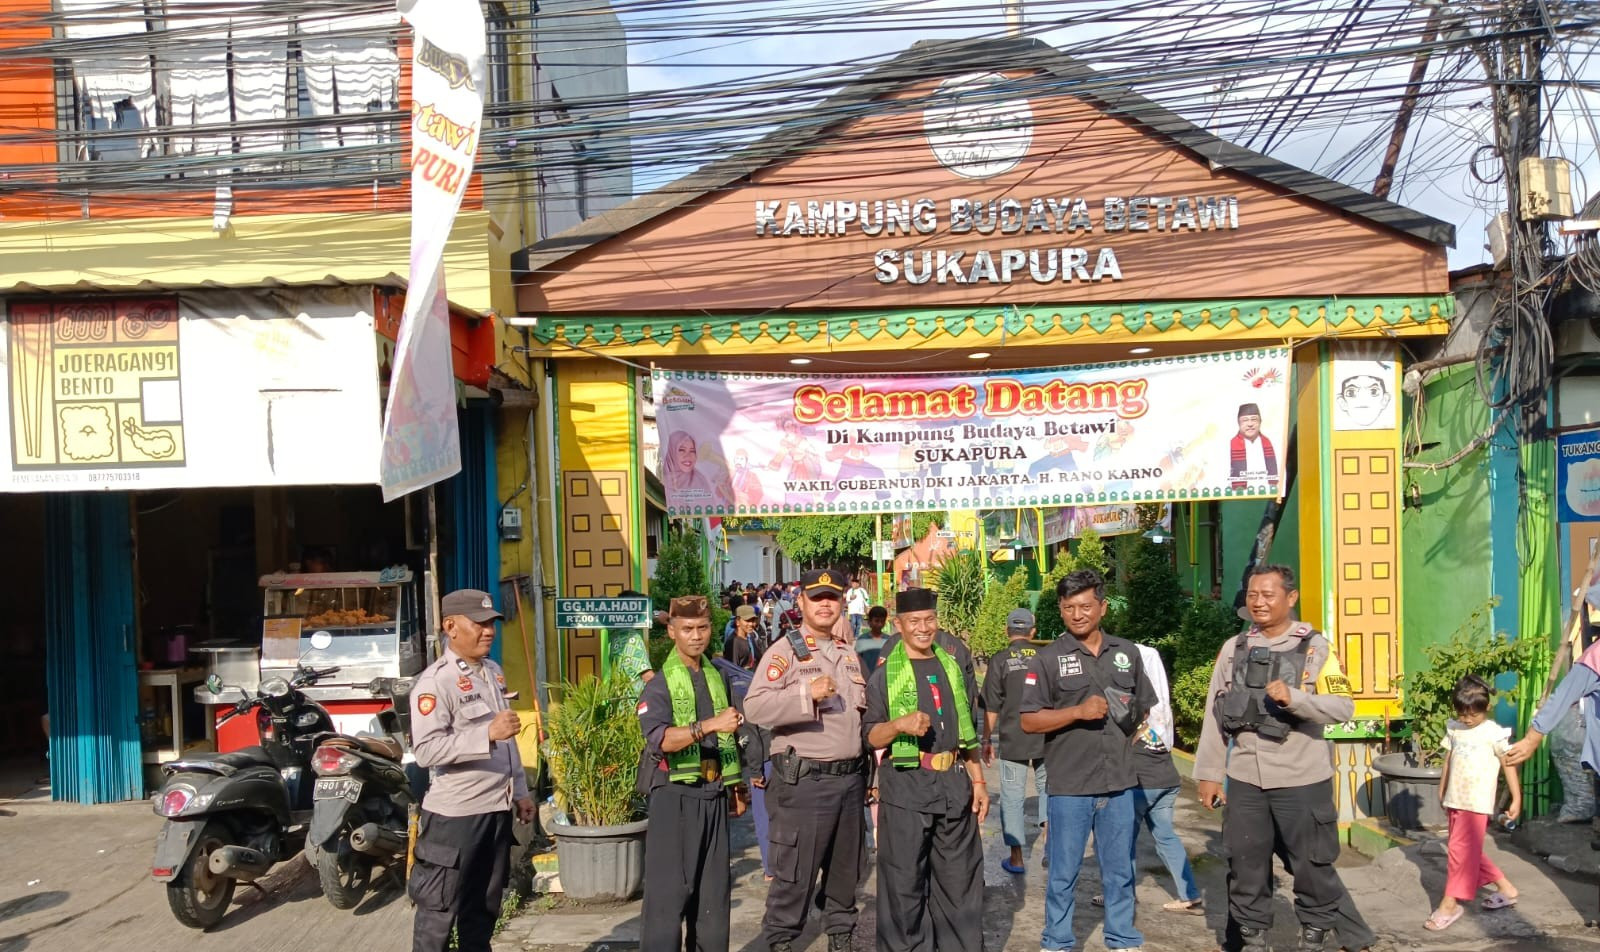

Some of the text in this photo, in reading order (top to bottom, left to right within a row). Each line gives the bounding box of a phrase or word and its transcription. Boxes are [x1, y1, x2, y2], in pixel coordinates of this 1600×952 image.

[755, 195, 1240, 236] KAMPUNG BUDAYA BETAWI
[874, 247, 1122, 284] SUKAPURA
[59, 352, 174, 373] JOERAGAN91
[61, 377, 114, 396] BENTO
[793, 378, 1148, 424] Selamat Datang
[827, 418, 1116, 446] Di Kampung Budaya Betawi
[914, 445, 1027, 463] SUKAPURA
[784, 479, 834, 492] WAKIL
[838, 477, 921, 491] GUBERNUR
[926, 475, 953, 489] DKI
[1039, 472, 1055, 485] H.
[1060, 470, 1103, 483] RANO
[1107, 467, 1163, 481] KARNO
[562, 601, 642, 612] GG.H.A.HADI
[566, 615, 599, 623] RT.001
[608, 615, 639, 623] RW.01
